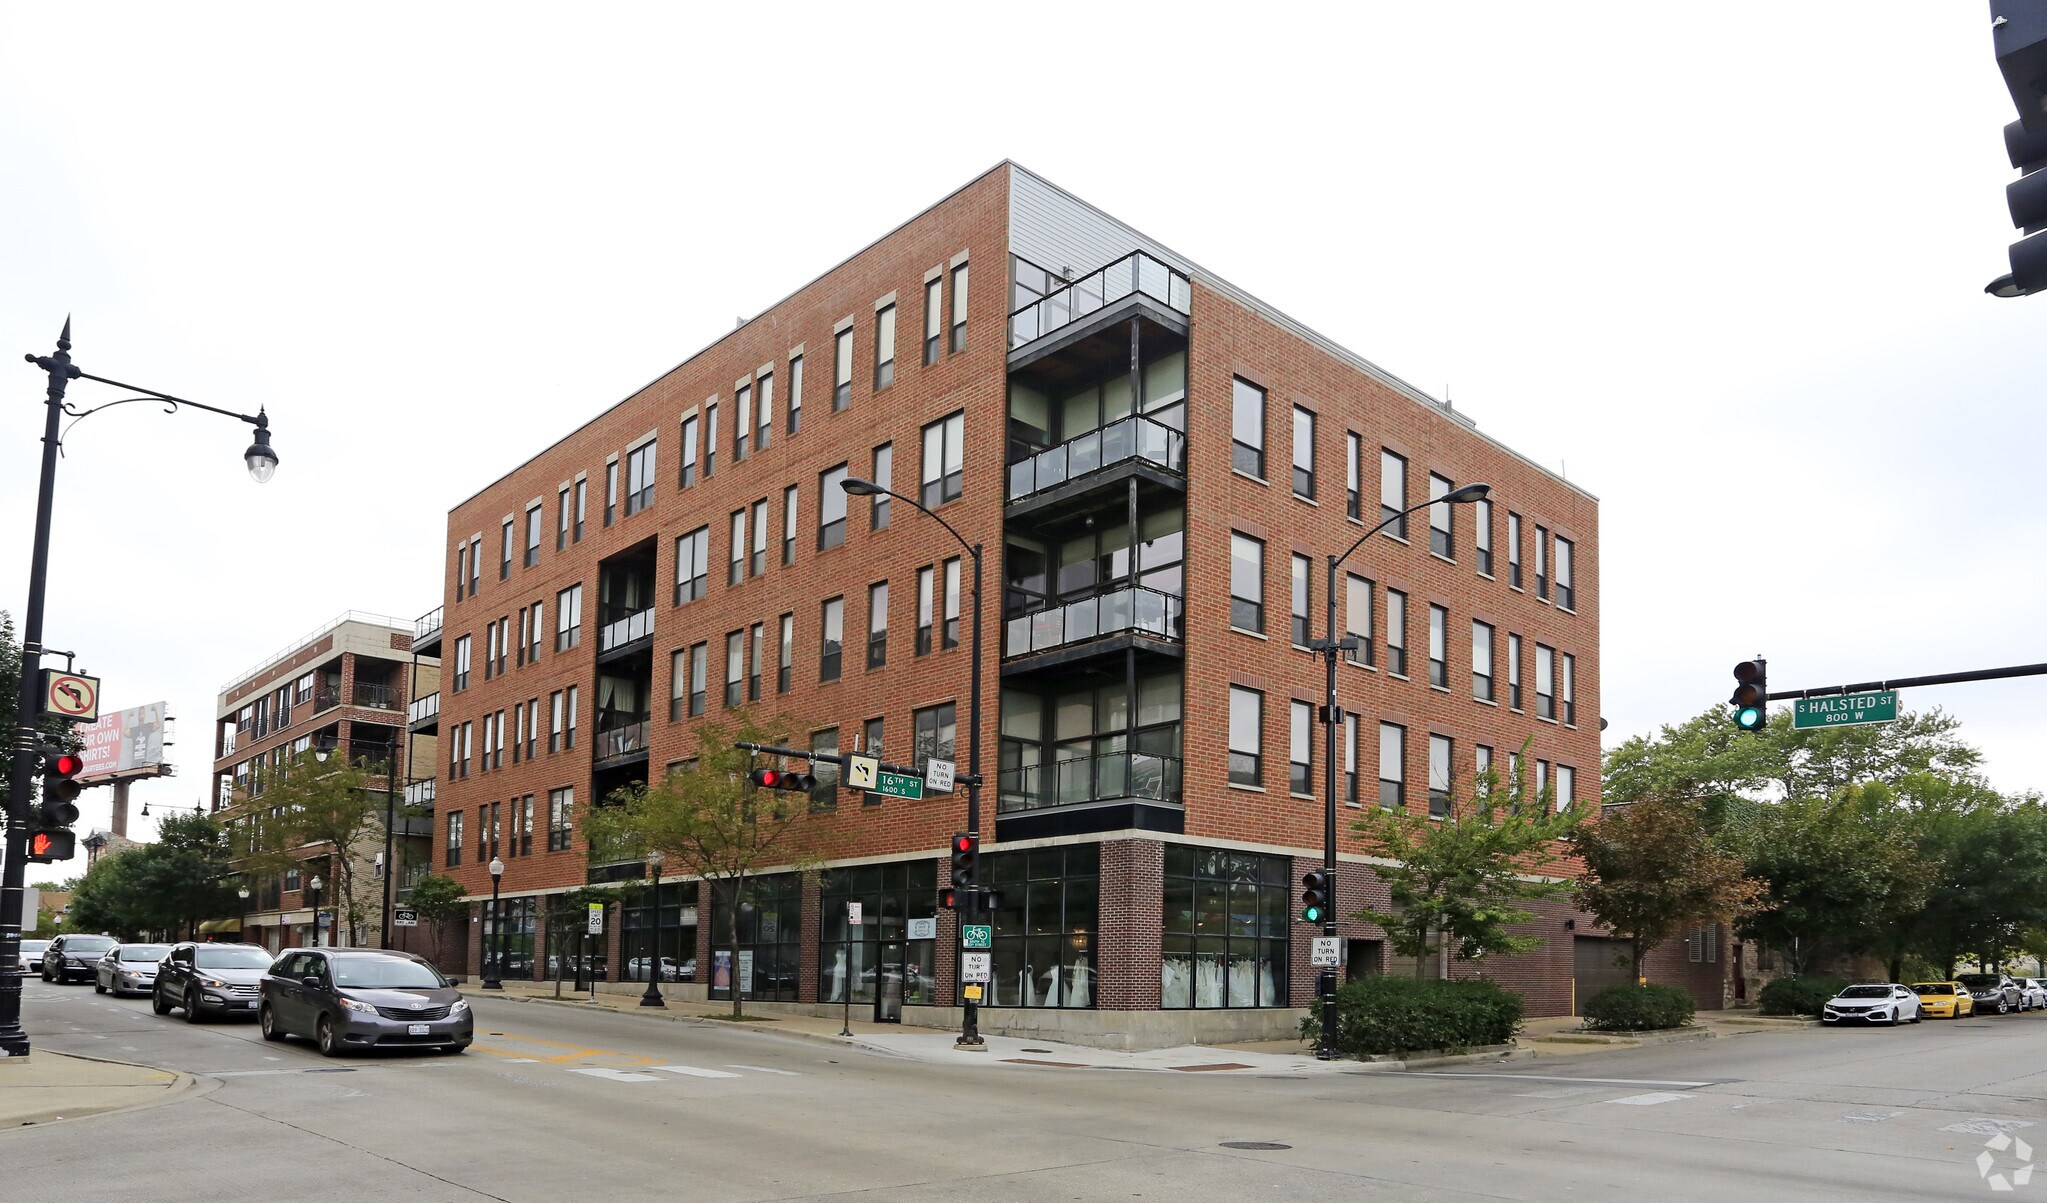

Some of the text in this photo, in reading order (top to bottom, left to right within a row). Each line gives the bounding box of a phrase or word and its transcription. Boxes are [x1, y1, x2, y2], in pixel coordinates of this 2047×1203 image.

[1799, 695, 1893, 714] S HALSTED ST
[1825, 711, 1864, 722] 800 W
[97, 728, 120, 744] OWN
[933, 770, 949, 779] TURN
[882, 775, 918, 788] 16TH ST
[940, 780, 951, 788] RED
[882, 785, 898, 794] 1600
[590, 917, 601, 925] 20
